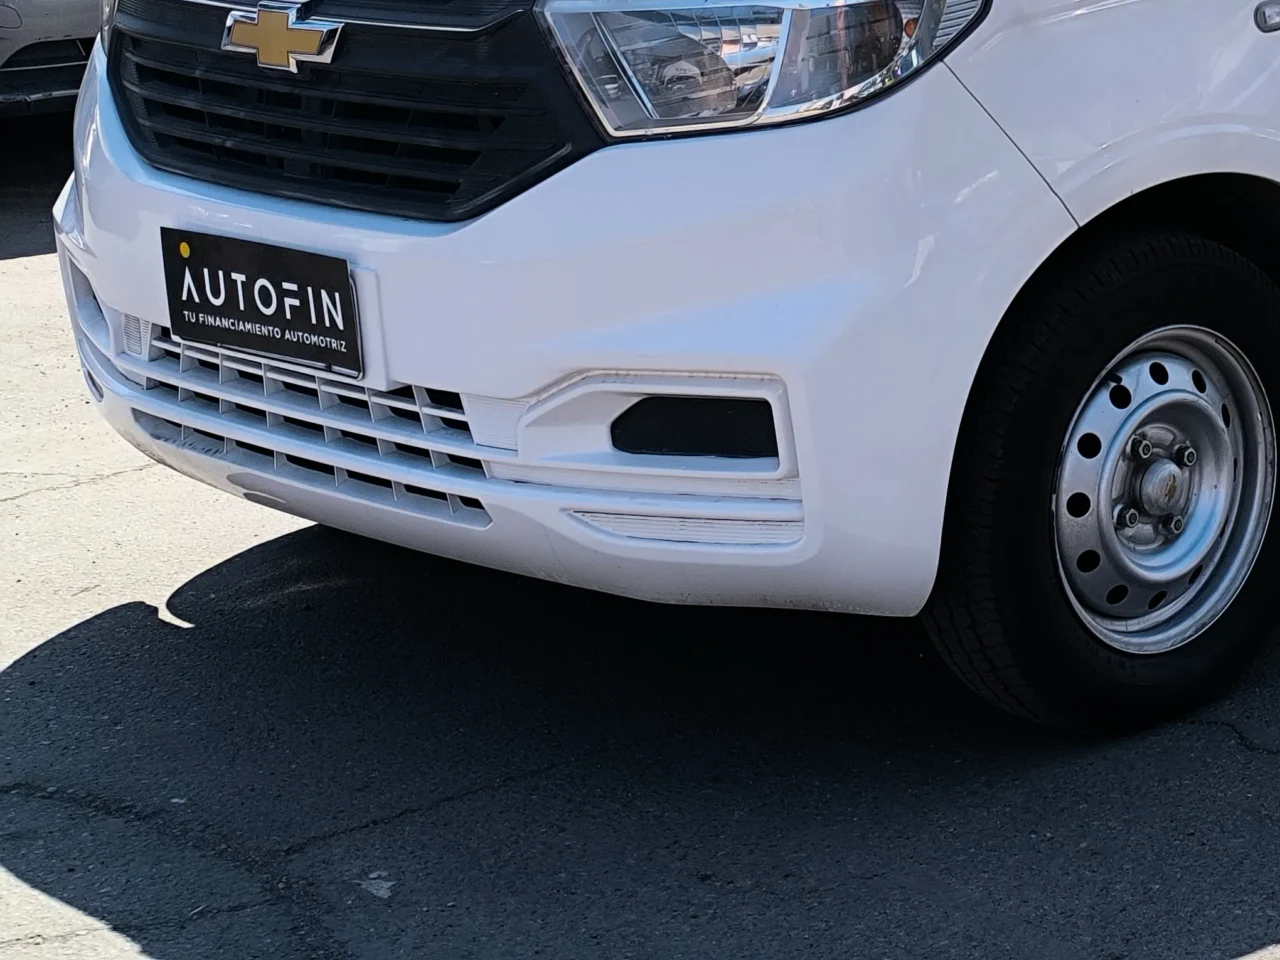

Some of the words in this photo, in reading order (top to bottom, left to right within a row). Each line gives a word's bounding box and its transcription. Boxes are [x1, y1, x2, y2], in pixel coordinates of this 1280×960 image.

[181, 265, 345, 331] AUTOFIN
[183, 310, 196, 323] TU
[199, 313, 281, 339] FINANCIAMIENTO
[284, 329, 347, 352] AUTOMOTRIZ
